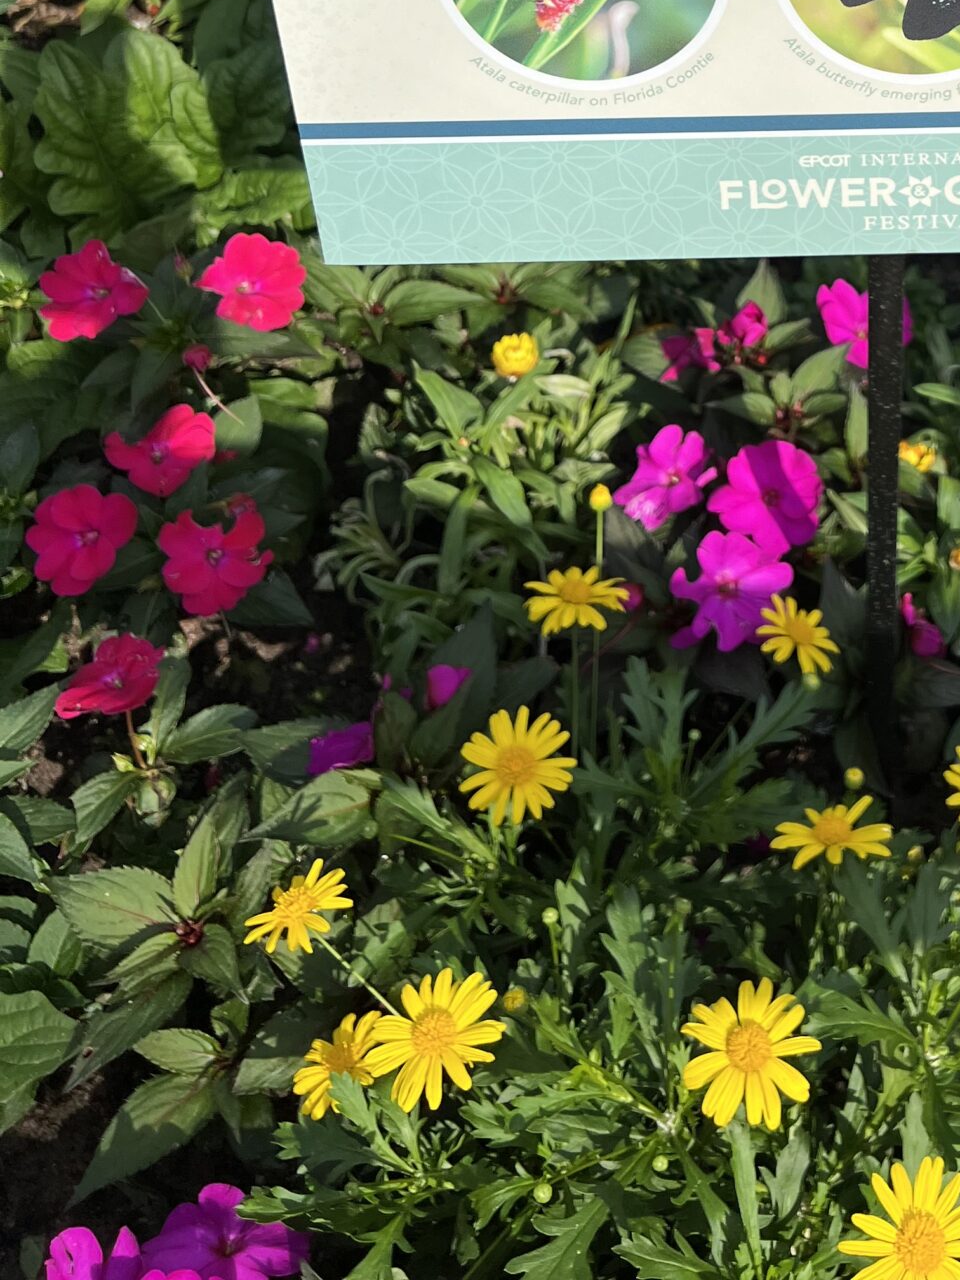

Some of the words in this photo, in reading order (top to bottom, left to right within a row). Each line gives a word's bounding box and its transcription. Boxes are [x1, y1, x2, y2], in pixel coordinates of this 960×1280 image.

[469, 56, 507, 82] Atala
[509, 80, 584, 106] caterpillar
[589, 96, 608, 106] on
[613, 85, 663, 105] Florida
[666, 50, 715, 89] Coontie
[783, 37, 816, 67] Atala
[816, 63, 877, 97] butterfly
[880, 87, 952, 103] emerging
[799, 154, 851, 168] EPCOT
[719, 177, 897, 210] FLOWER
